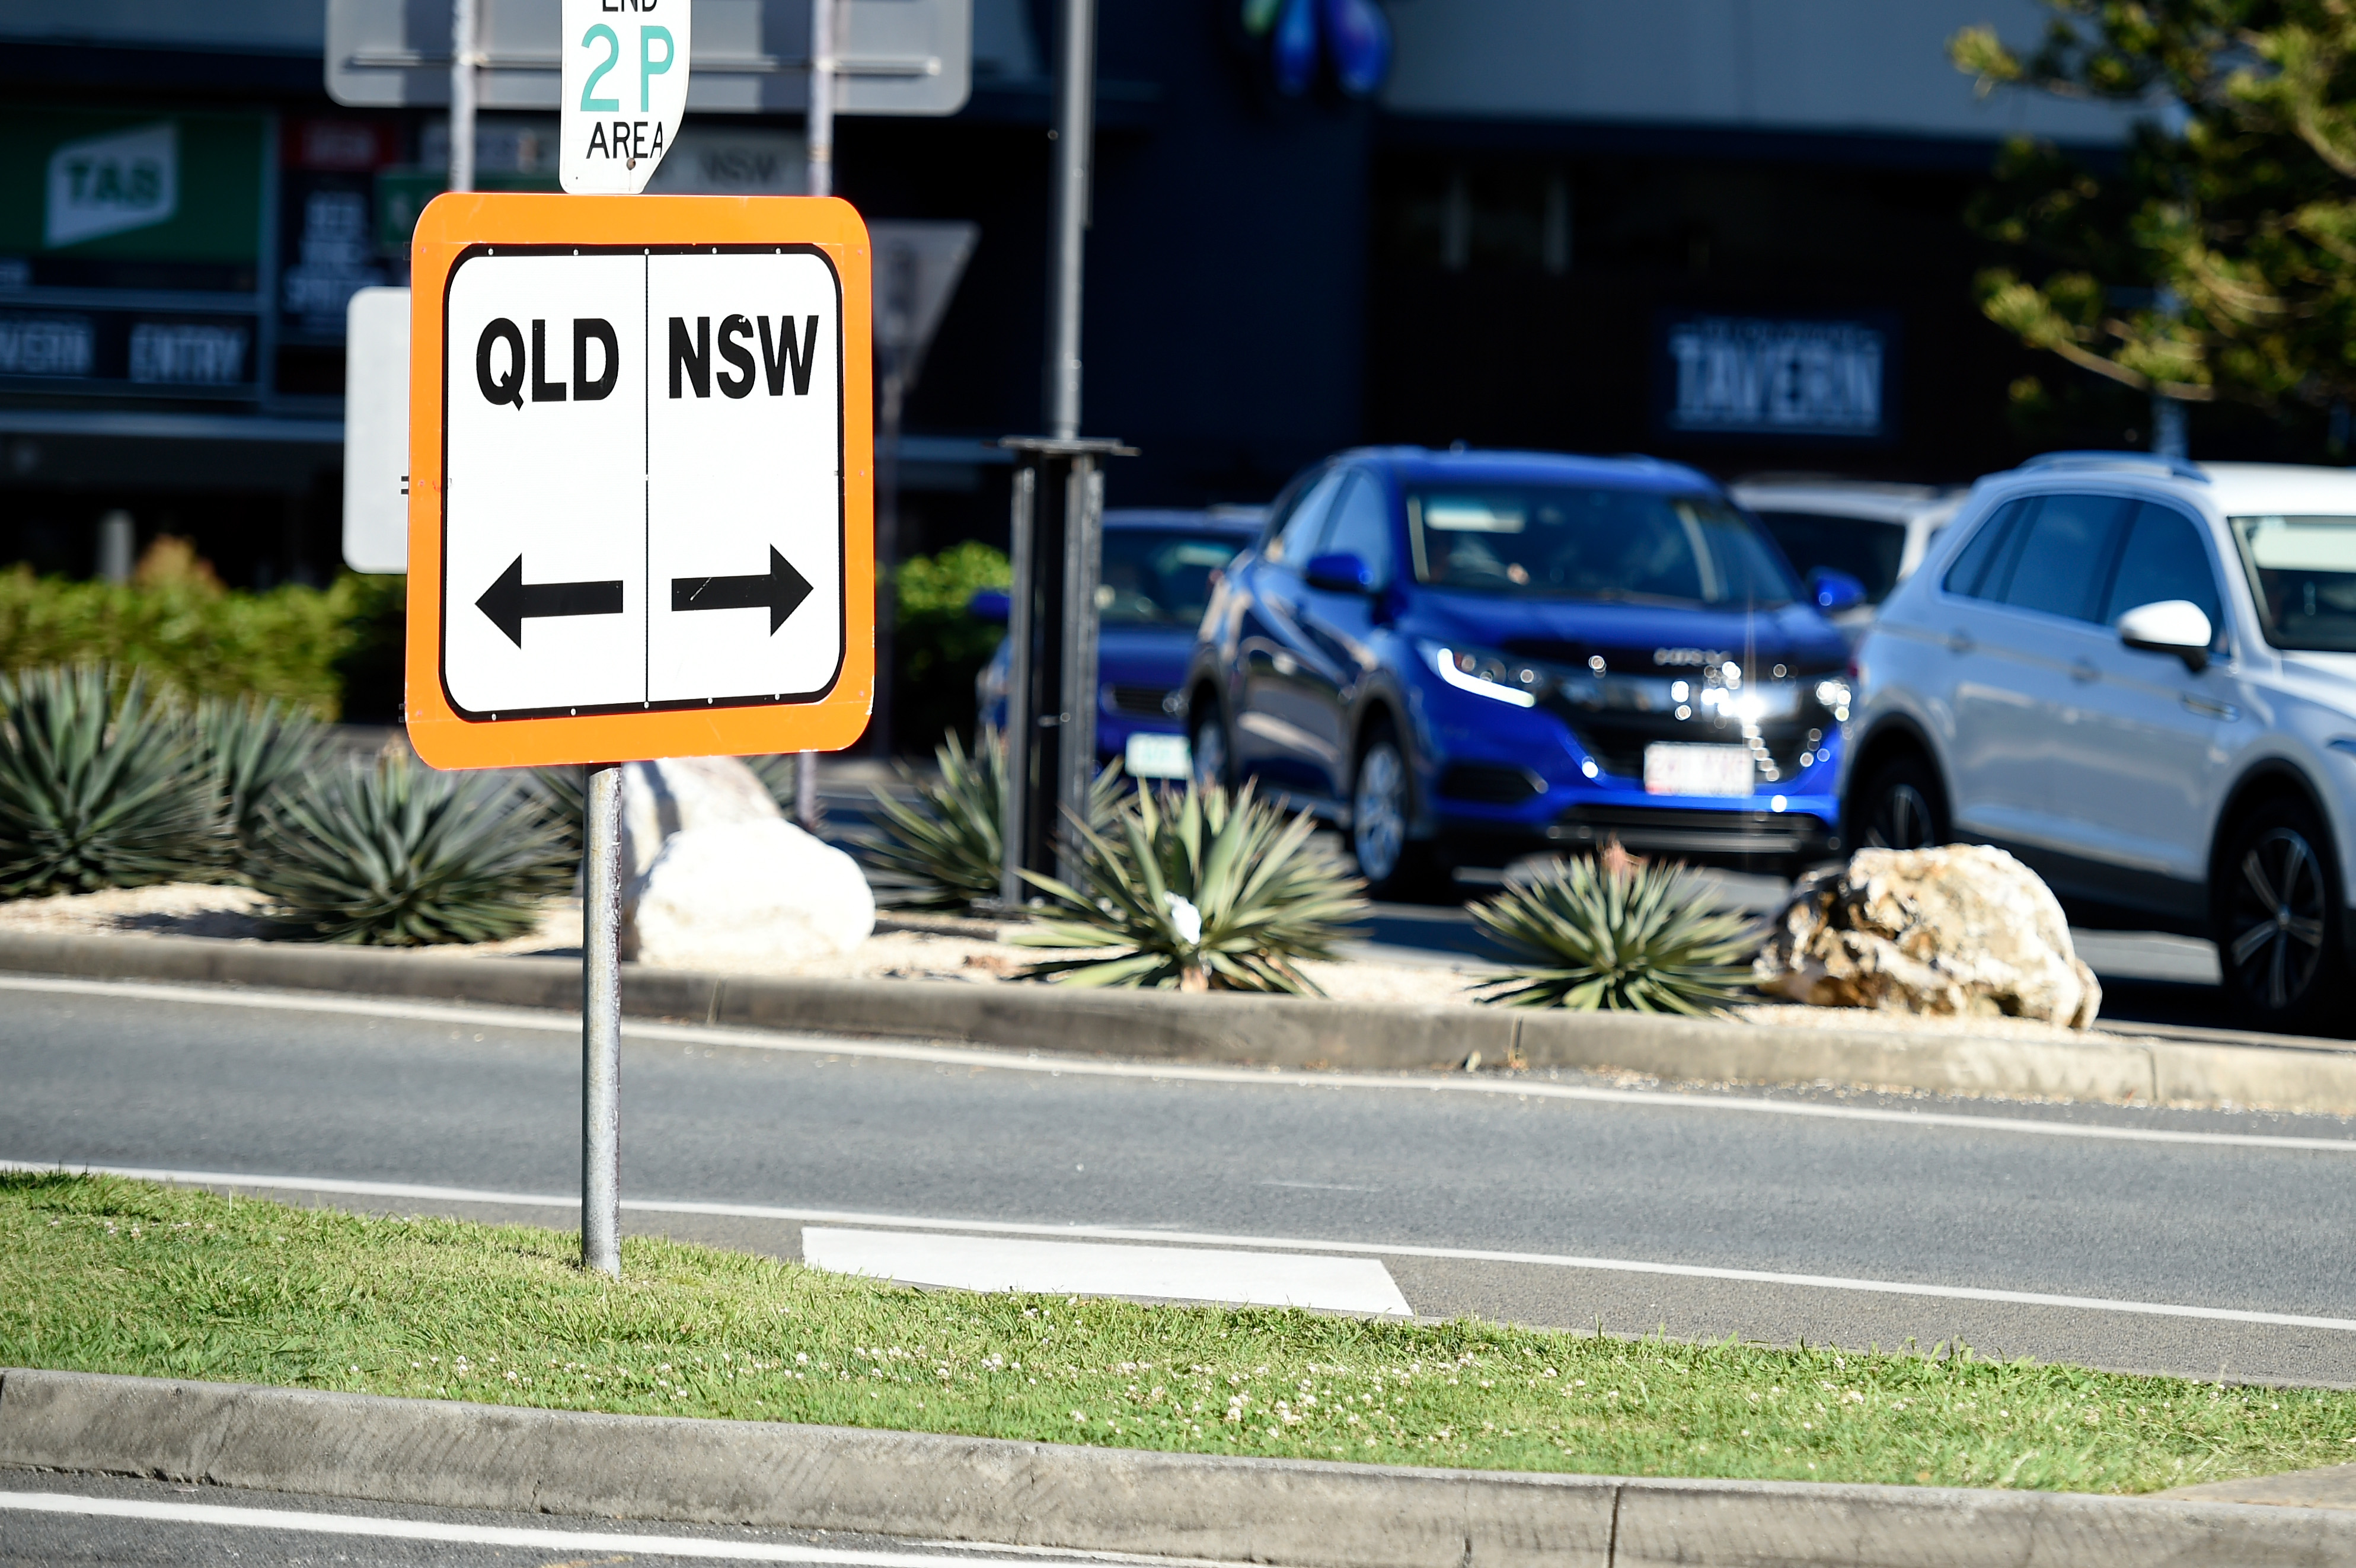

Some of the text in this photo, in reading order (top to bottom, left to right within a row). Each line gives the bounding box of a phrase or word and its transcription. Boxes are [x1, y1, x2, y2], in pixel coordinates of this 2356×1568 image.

[586, 122, 663, 159] AREA
[130, 324, 249, 385] ENTRY
[476, 318, 620, 411] QLD
[669, 314, 819, 400] NSW
[1669, 331, 1885, 427] TAVERN
